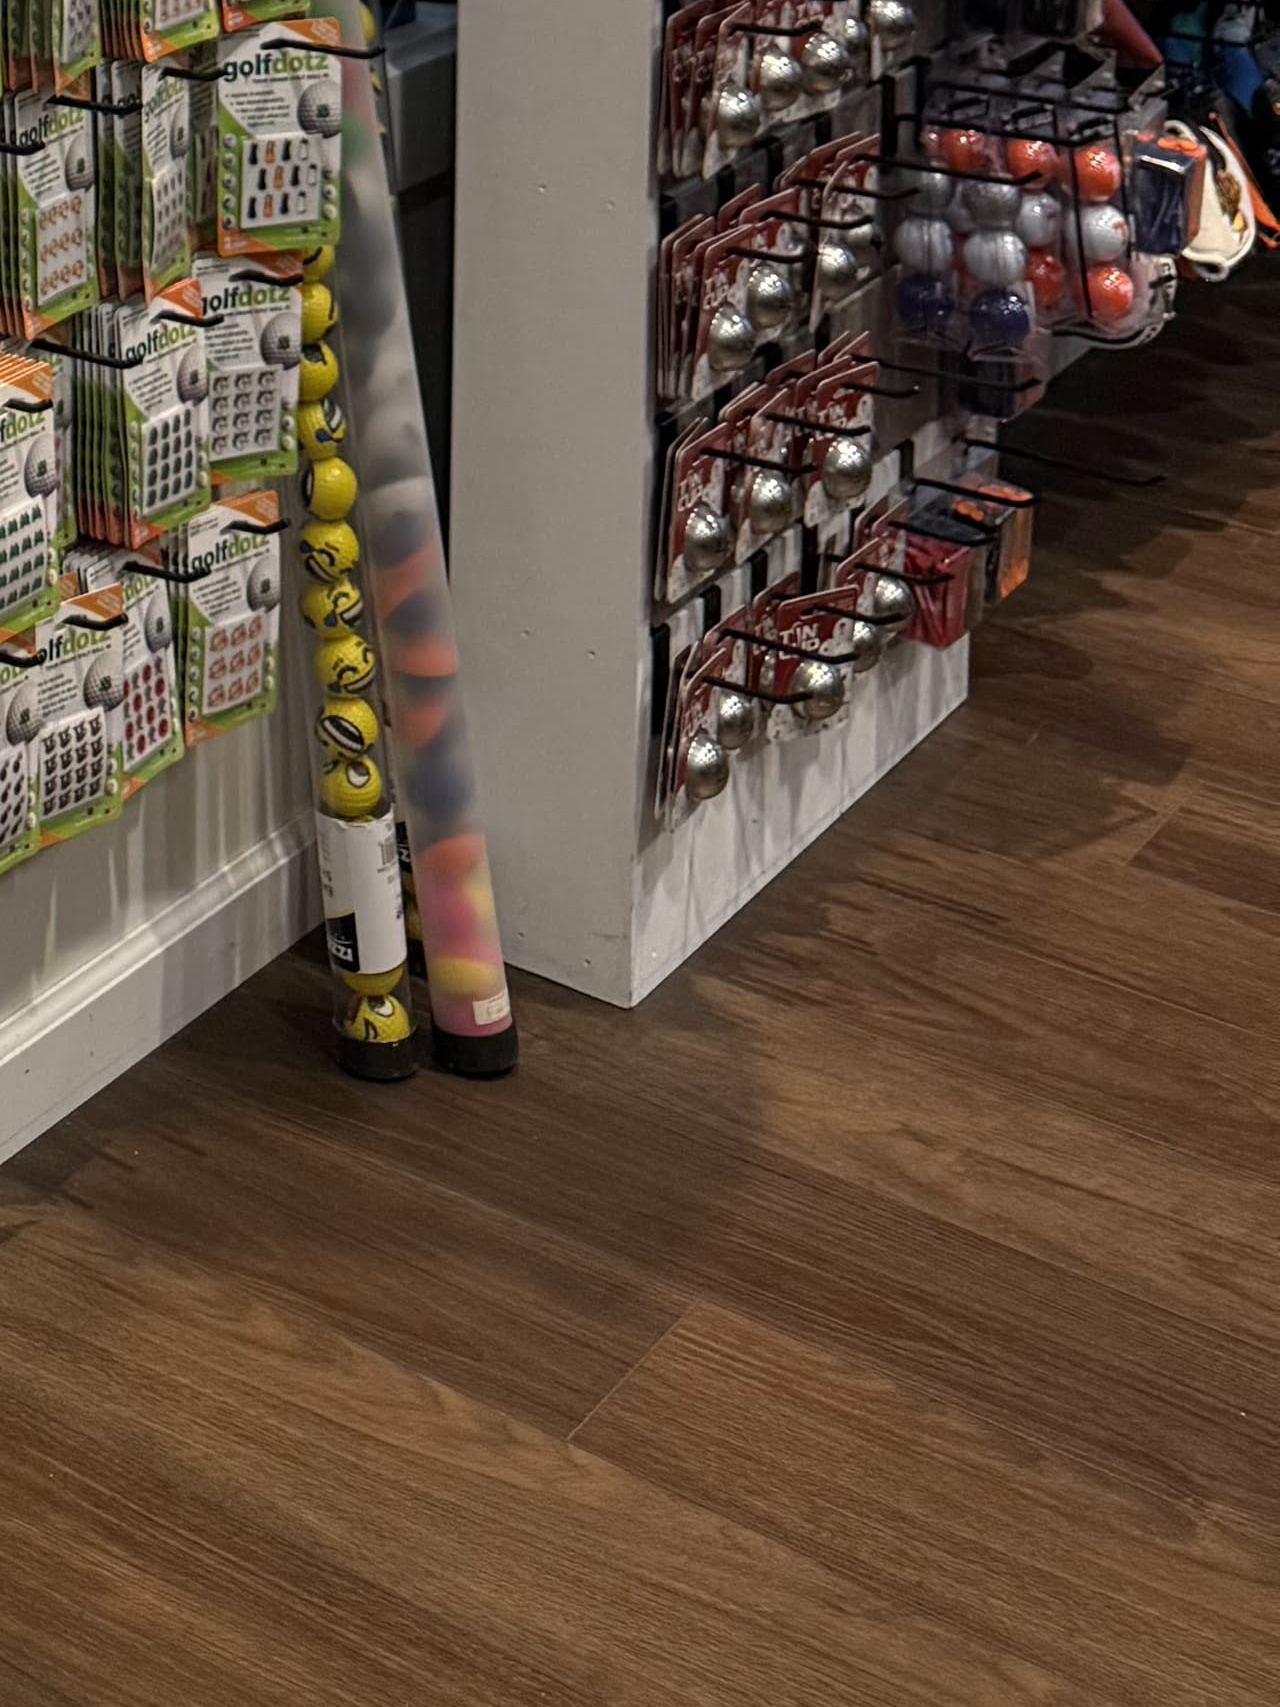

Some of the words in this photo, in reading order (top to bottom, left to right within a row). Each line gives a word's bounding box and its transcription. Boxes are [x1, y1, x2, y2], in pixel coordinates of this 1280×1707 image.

[224, 49, 328, 82] golfdotz
[20, 111, 83, 147] golfdotz
[126, 323, 196, 364] golfdotz
[191, 537, 268, 577] golfdotz
[779, 621, 820, 647] TIN
